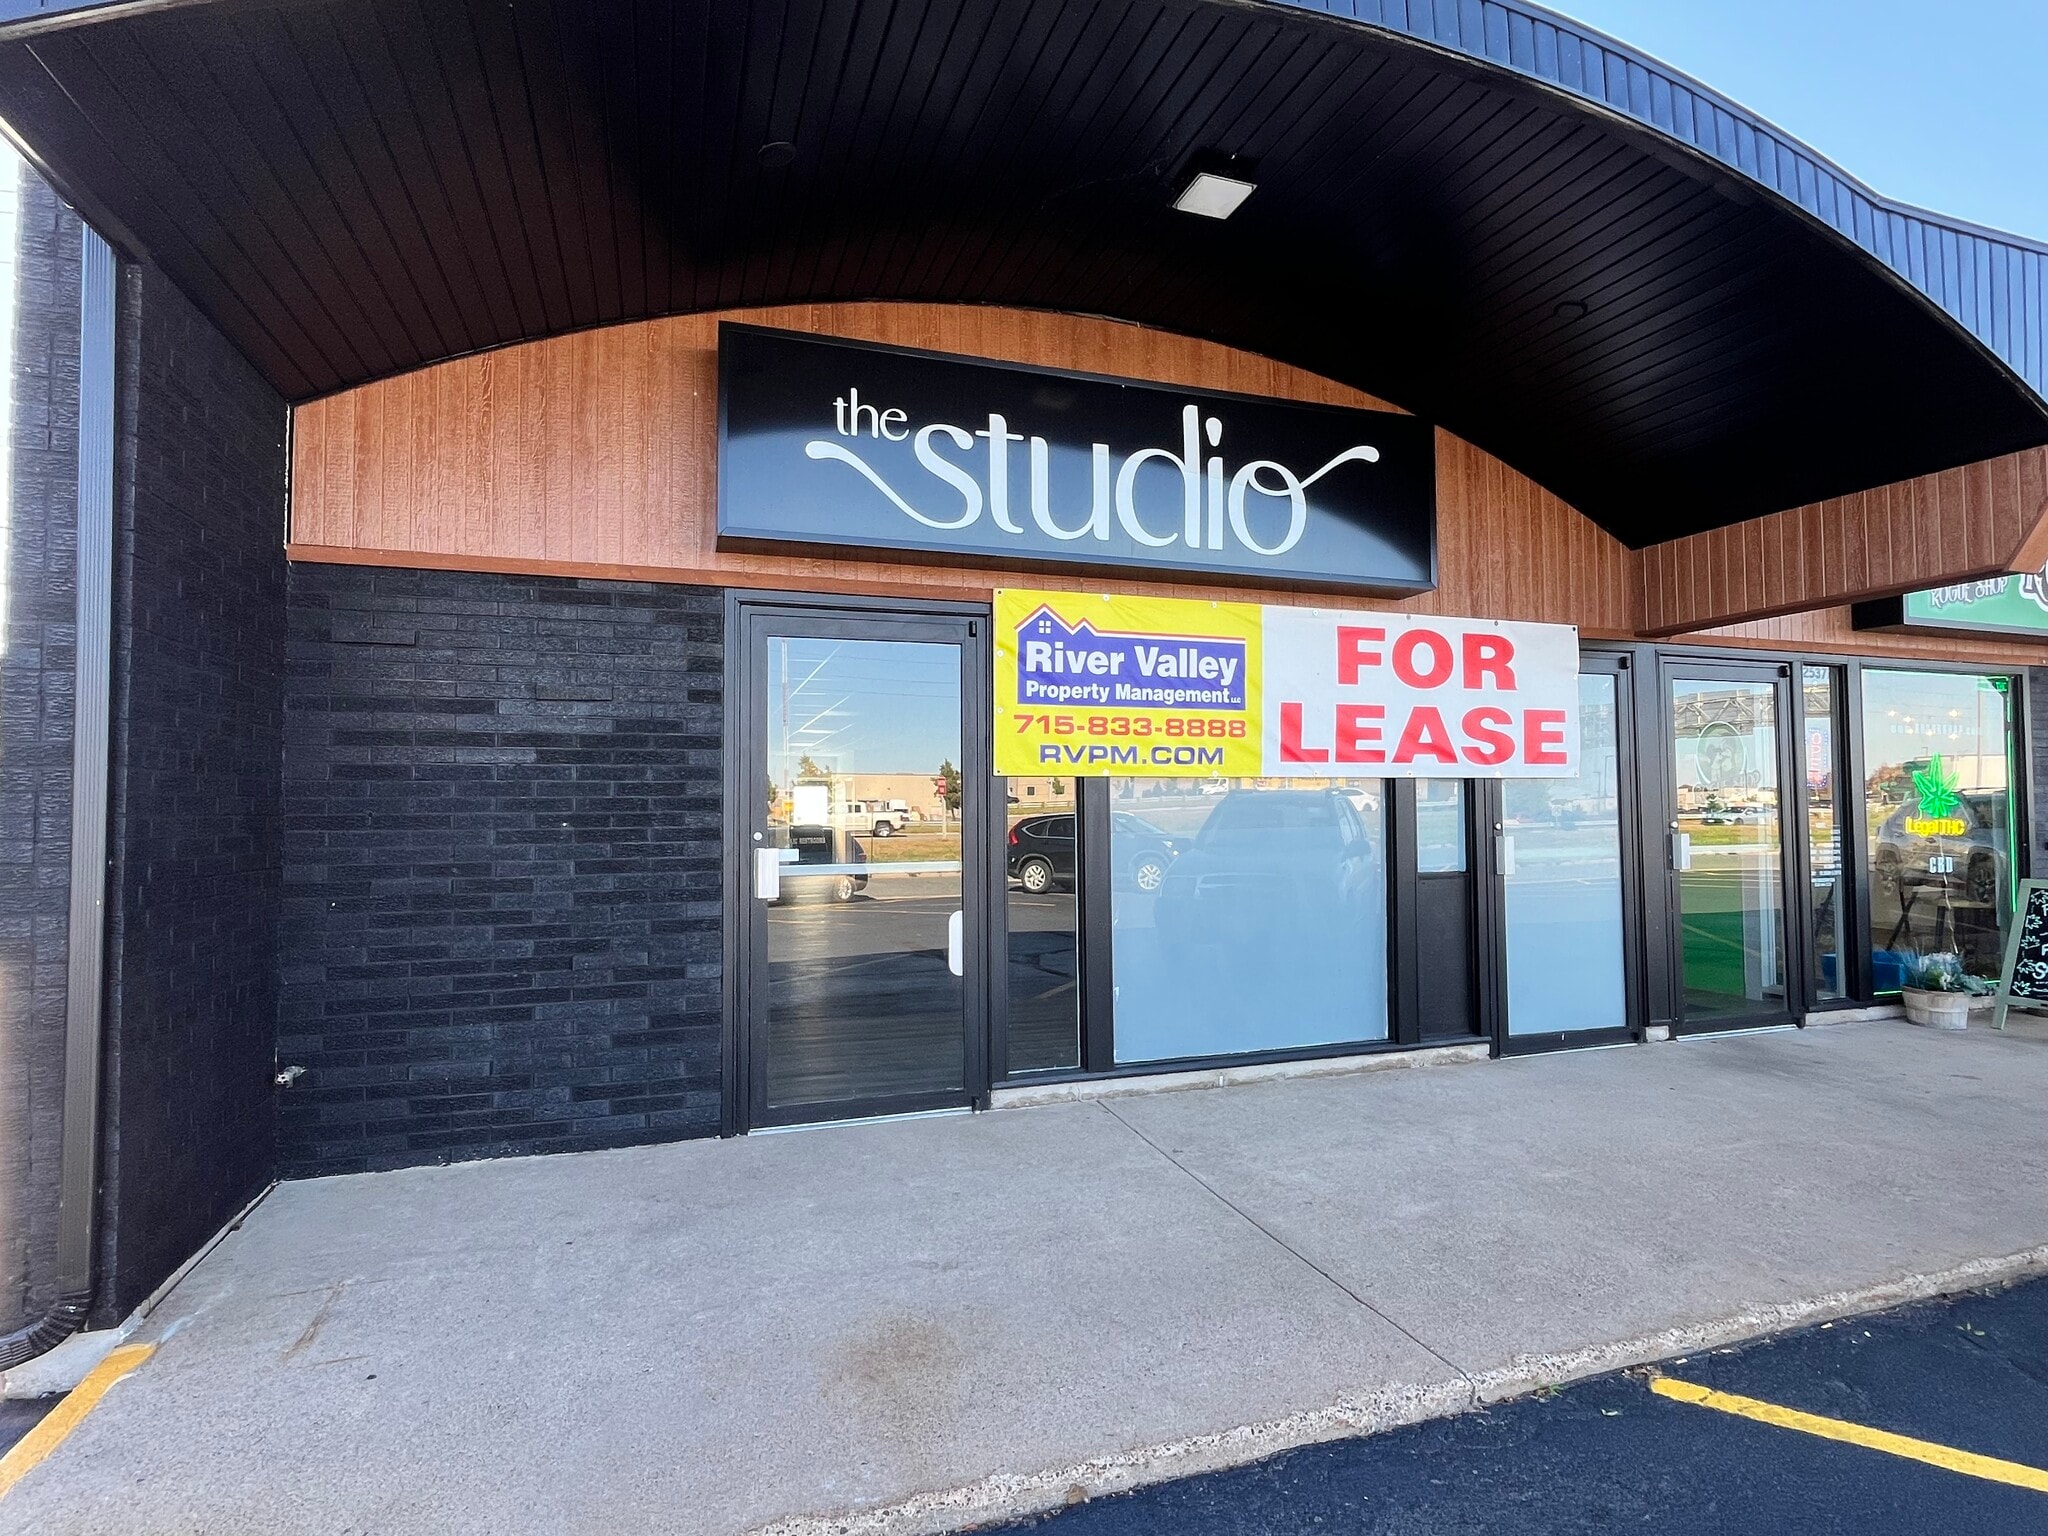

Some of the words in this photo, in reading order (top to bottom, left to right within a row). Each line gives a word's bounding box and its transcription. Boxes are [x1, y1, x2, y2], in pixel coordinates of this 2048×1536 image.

[832, 387, 910, 442] the
[804, 404, 1380, 556] studio
[1025, 640, 1125, 676] River
[1134, 646, 1238, 687] Valley
[1336, 625, 1518, 691] FOR
[1803, 667, 1827, 680] 2537
[1026, 681, 1111, 704] Property
[1115, 684, 1231, 705] Management
[1013, 714, 1247, 739] 715-833-8888
[1280, 702, 1568, 766] LEASE
[1039, 744, 1225, 766] RVPM.COM
[1929, 856, 1954, 874] CBD
